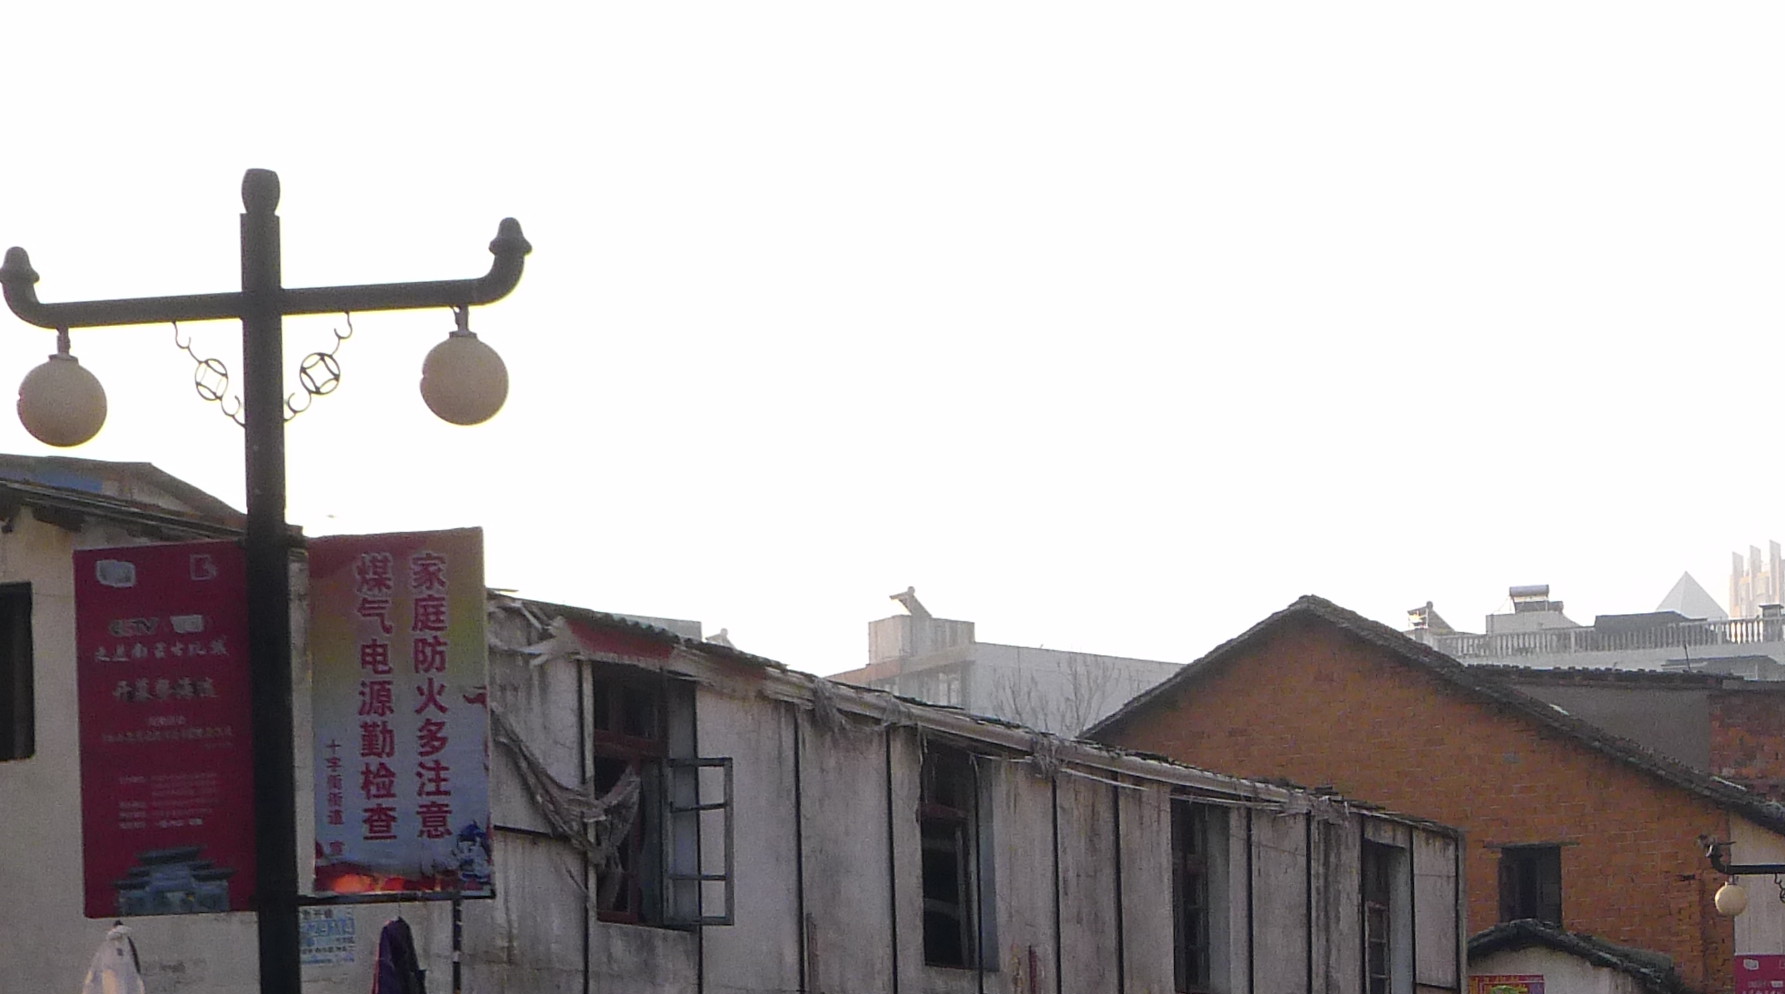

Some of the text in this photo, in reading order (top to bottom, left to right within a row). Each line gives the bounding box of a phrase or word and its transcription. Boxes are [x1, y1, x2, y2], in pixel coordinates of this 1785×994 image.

[326, 739, 345, 826] 十字街街道
[356, 551, 399, 842] 煤气电源勤检查
[410, 551, 453, 841] 家庭防火多注意
